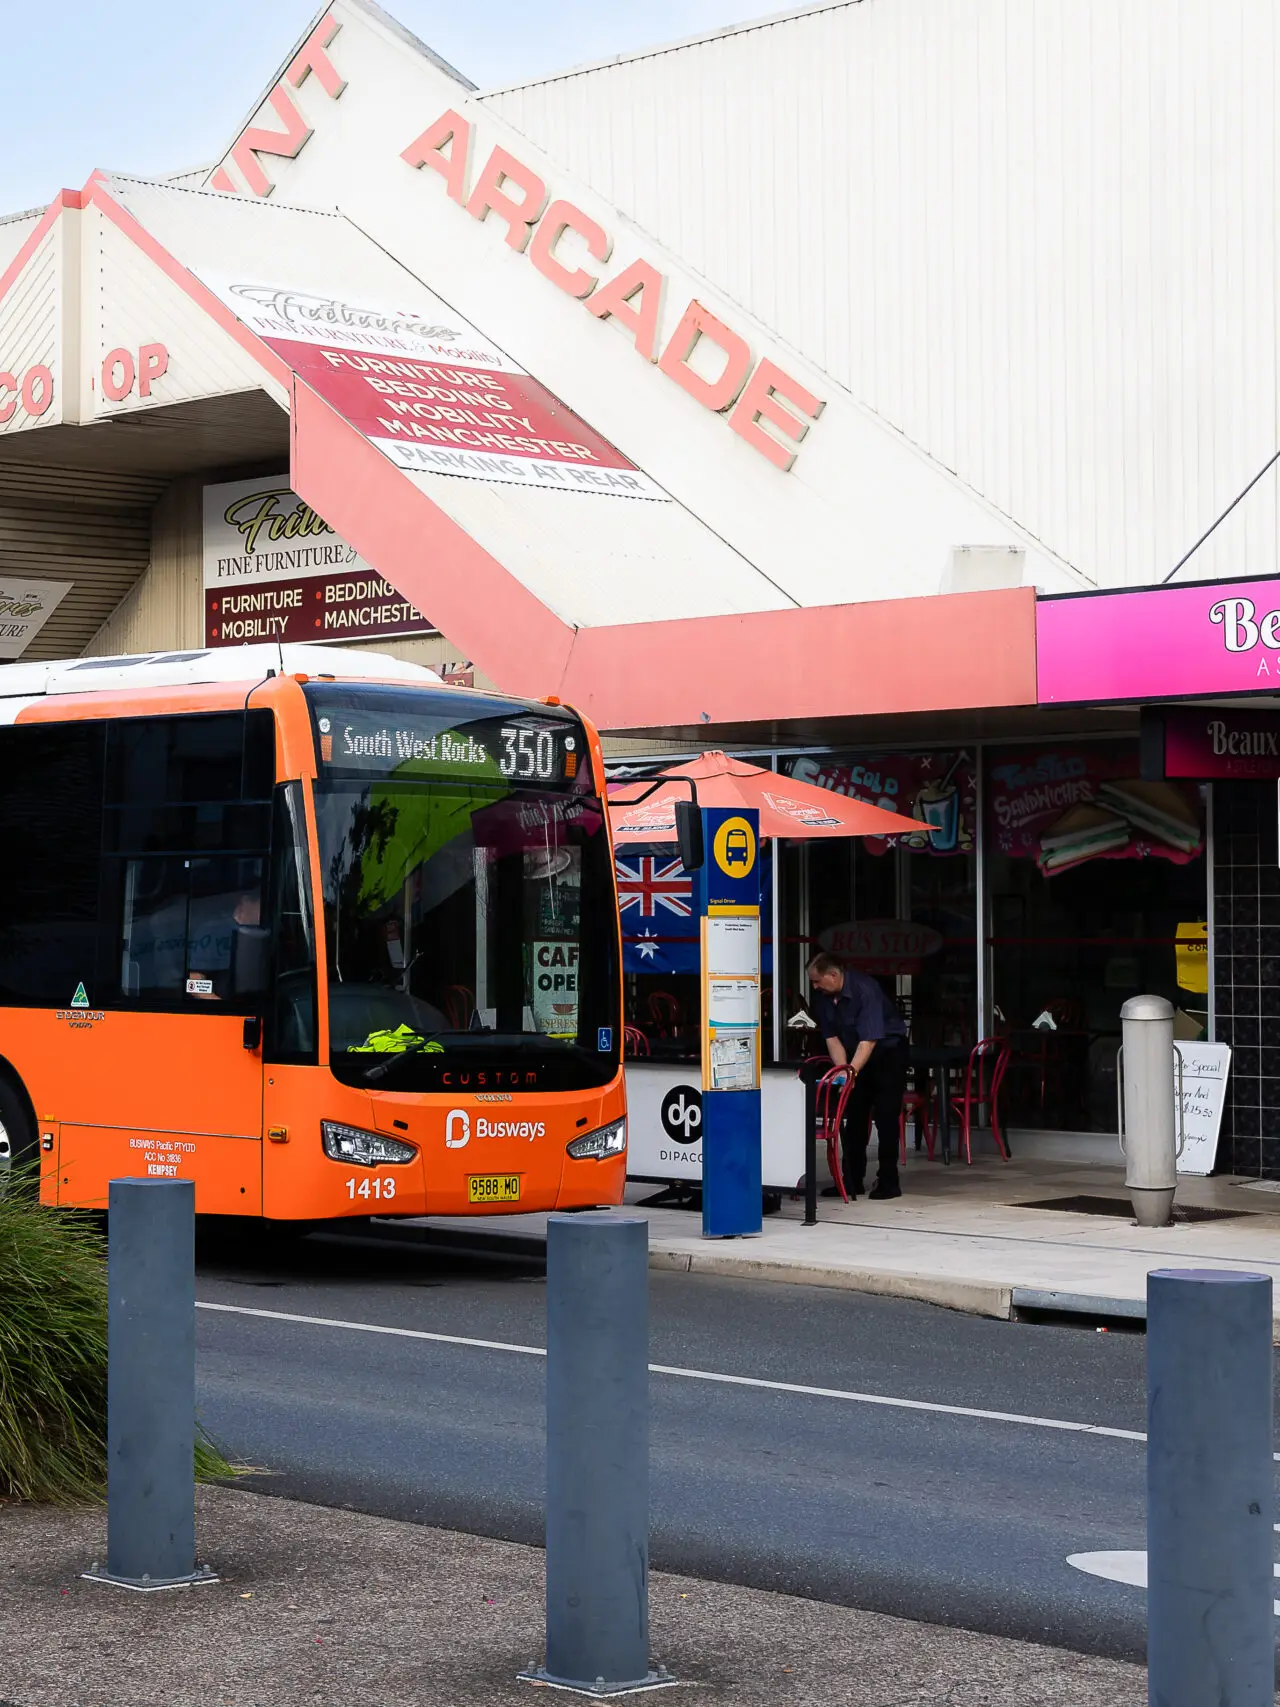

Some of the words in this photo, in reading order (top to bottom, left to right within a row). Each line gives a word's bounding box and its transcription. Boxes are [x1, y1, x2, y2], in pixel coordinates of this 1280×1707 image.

[399, 108, 826, 473] ARCADE
[229, 284, 461, 341] Futures
[252, 316, 301, 335] FINE
[305, 322, 414, 351] FURNITURE
[428, 343, 502, 367] Mobility
[102, 343, 169, 401] OP
[320, 350, 506, 392] FURNITURE
[363, 376, 513, 411] BEDDING
[383, 398, 537, 433] MOBILITY
[377, 416, 600, 461] MANCHESTER
[394, 444, 523, 477] PARKING
[530, 463, 565, 482] AT
[567, 467, 646, 492] REAR
[217, 555, 253, 577] FINE
[255, 544, 344, 574] FURNITURE
[222, 589, 303, 615] FURNITURE
[325, 579, 396, 604] BEDDING
[221, 616, 289, 640] MOBILITY
[324, 602, 425, 630] MANCHESTE
[343, 726, 392, 757] South
[395, 730, 438, 760] West
[441, 735, 486, 763] Rocks
[500, 728, 553, 777] 350
[1207, 720, 1279, 755] Beaux
[994, 780, 1094, 827] SANDWICHES
[830, 931, 872, 952] BUS
[879, 932, 935, 953] STOP
[538, 974, 579, 991] OPE
[442, 1072, 537, 1085] CUSTOM
[475, 1094, 512, 1103] VOLVO
[668, 1094, 702, 1137] dp
[129, 1138, 155, 1149] BUSWAYS
[156, 1140, 173, 1151] Pacific
[476, 1118, 545, 1142] Busways
[144, 1152, 157, 1161] ACC
[157, 1153, 166, 1162] No
[147, 1164, 177, 1176] KEMPSEY
[345, 1177, 396, 1199] 1413
